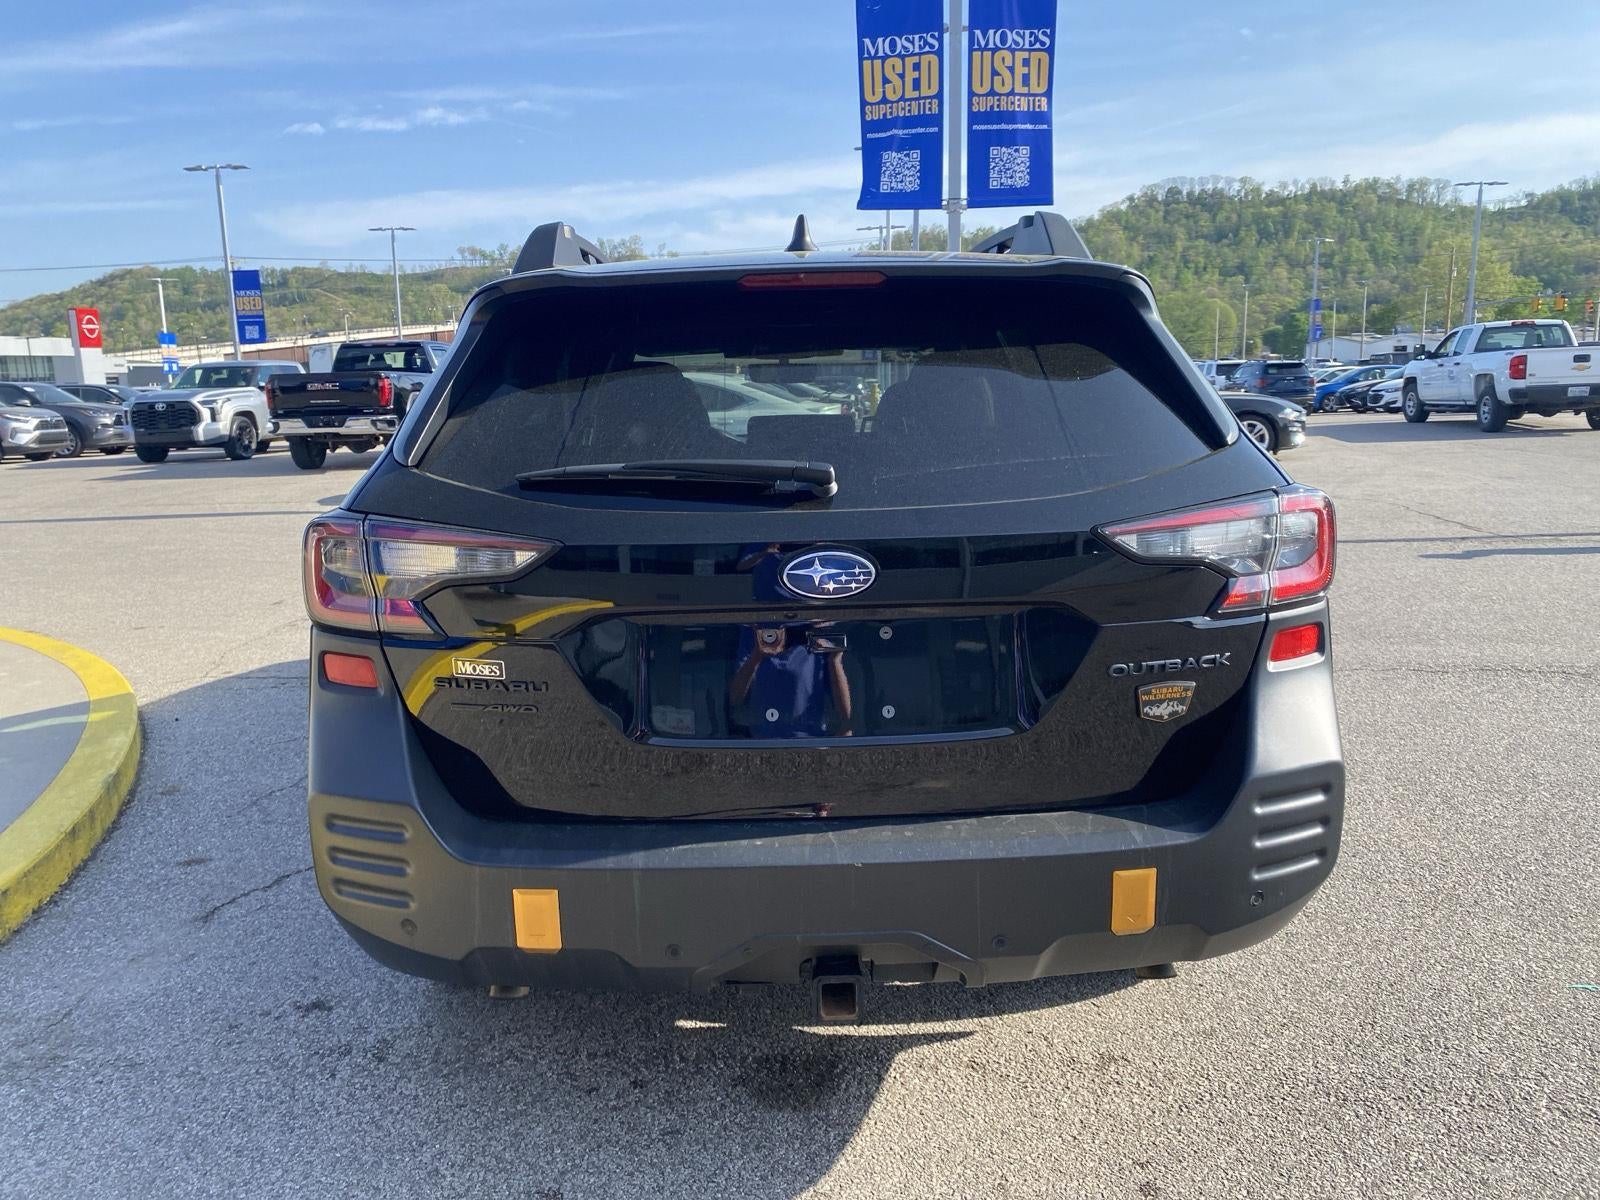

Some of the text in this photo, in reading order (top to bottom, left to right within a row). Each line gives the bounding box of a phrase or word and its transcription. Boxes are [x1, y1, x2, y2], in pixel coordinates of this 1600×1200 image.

[862, 32, 939, 57] MOSES
[973, 28, 1051, 49] MOSES
[863, 54, 939, 103] USED
[971, 50, 1050, 94] USED
[865, 99, 939, 121] SUPERCENTER
[972, 95, 1048, 112] SUPERCENTER
[235, 289, 261, 297] MOSES
[235, 297, 262, 310] USED
[457, 660, 500, 676] MOSES
[1108, 652, 1231, 677] OUTBACK
[434, 676, 549, 692] SUBARU
[1151, 686, 1184, 695] SUBARU
[1142, 690, 1193, 701] WILDERNESS
